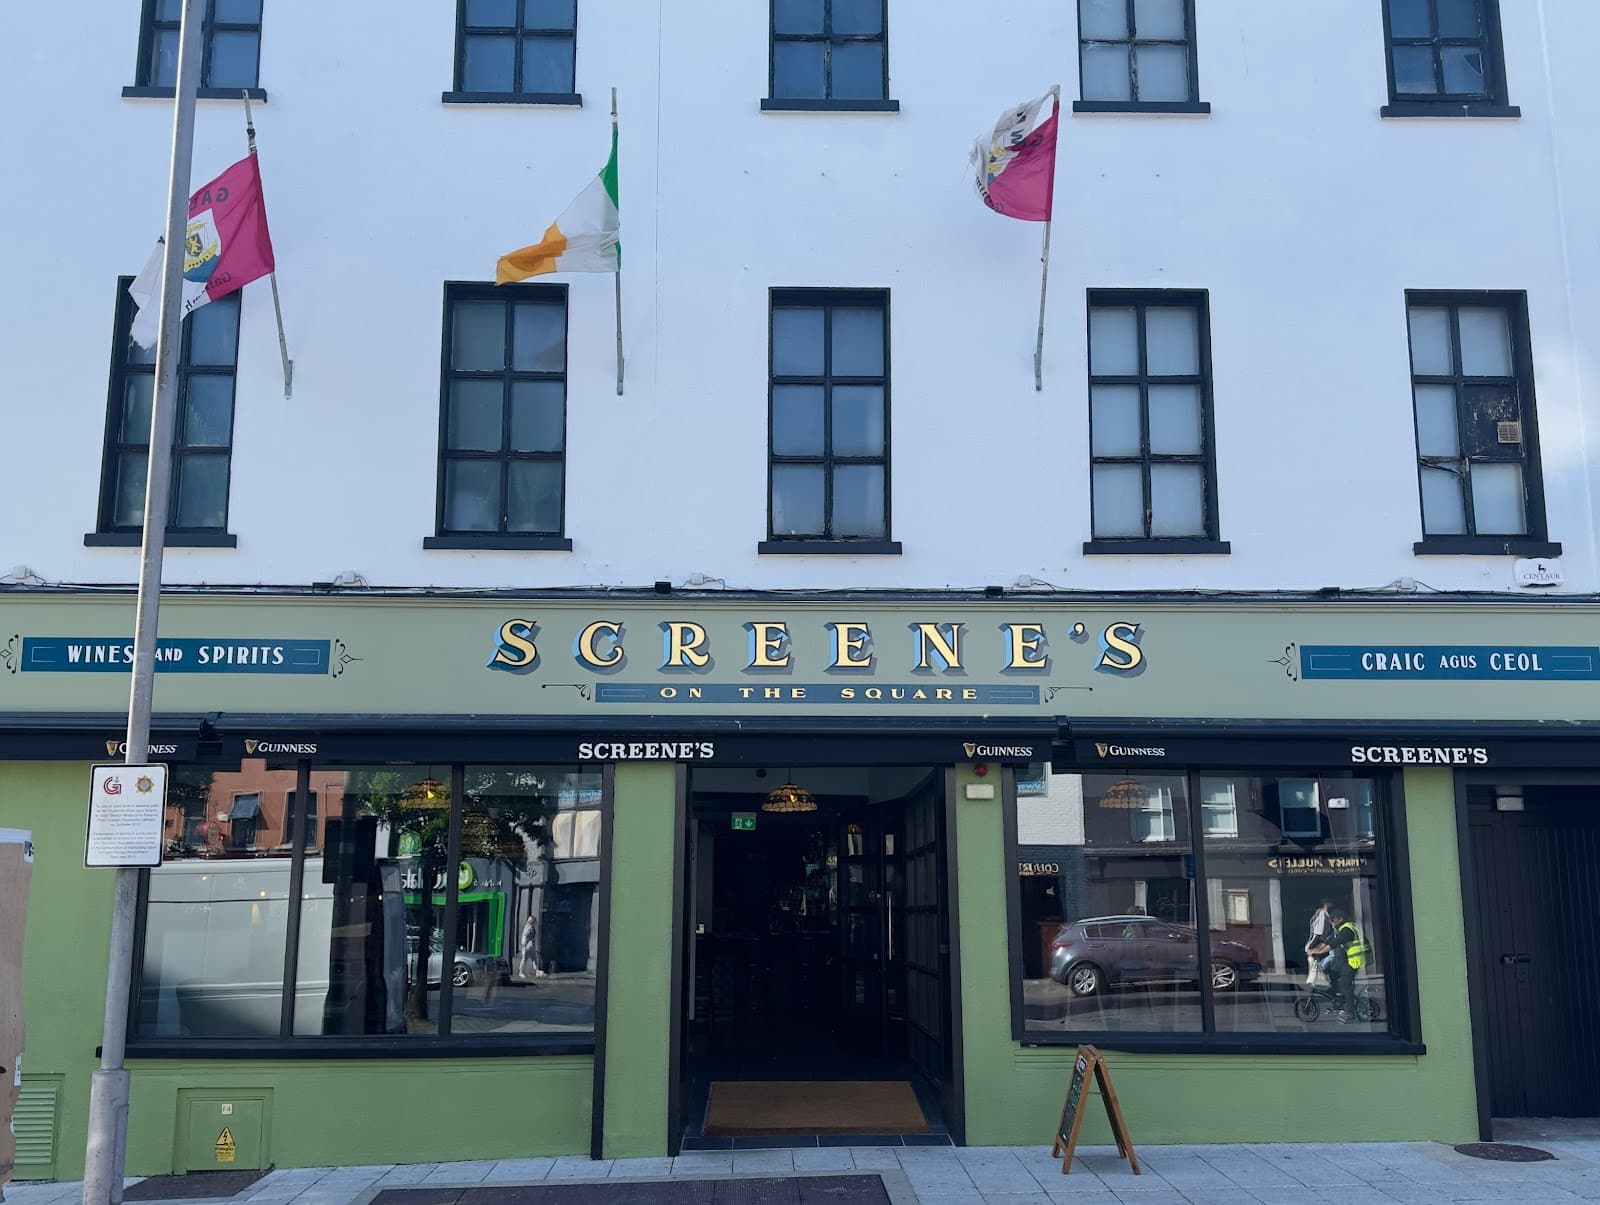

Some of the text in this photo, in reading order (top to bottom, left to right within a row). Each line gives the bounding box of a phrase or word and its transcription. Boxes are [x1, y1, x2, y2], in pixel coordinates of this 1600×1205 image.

[67, 645, 285, 665] WINES AND SPIRITS
[488, 618, 1148, 676] SCREENE'S
[1361, 652, 1543, 671] CRAIC AGUS CEOL
[659, 687, 978, 700] ON THE SQUARE
[258, 741, 318, 754] GUINNESS
[578, 742, 714, 759] SCREENE'S
[977, 745, 1034, 757] GUINNESS
[1109, 745, 1166, 757] GUINNESS
[1351, 746, 1489, 764] SCREENE'S
